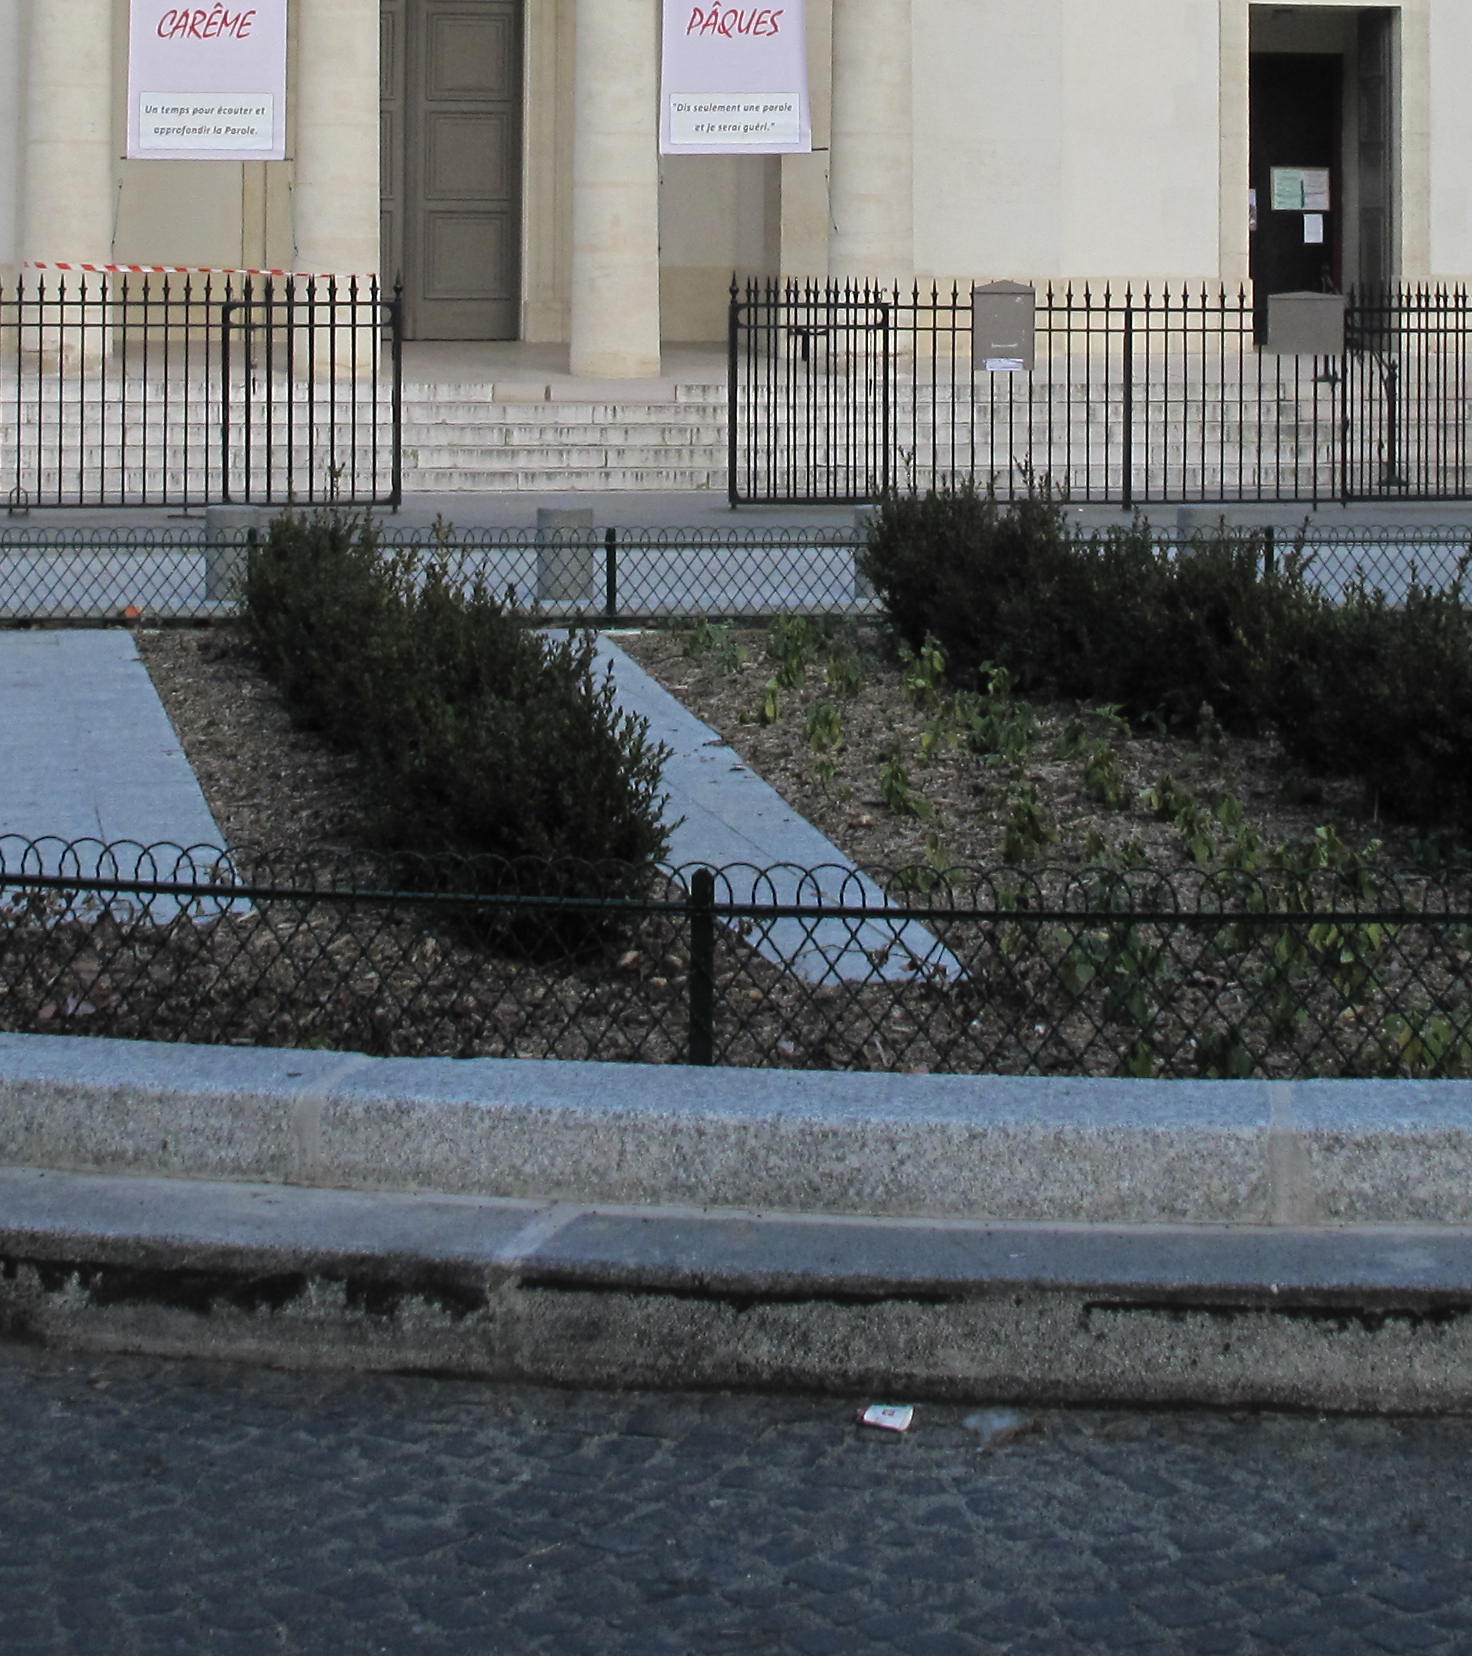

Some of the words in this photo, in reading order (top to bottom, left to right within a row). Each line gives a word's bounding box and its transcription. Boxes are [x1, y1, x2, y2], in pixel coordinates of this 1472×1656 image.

[156, 1, 257, 40] CARÊME
[686, 0, 784, 39] PÂQUES
[144, 105, 158, 114] Un
[161, 105, 190, 116] temps
[192, 106, 215, 116] pour
[217, 105, 253, 115] écouter
[255, 107, 266, 115] et
[693, 103, 741, 113] seulement
[743, 104, 760, 113] une
[762, 103, 793, 114] parole
[153, 125, 211, 137] approfondir
[213, 126, 222, 135] la
[694, 123, 705, 132] et
[706, 123, 716, 134] je
[717, 123, 742, 132] serai
